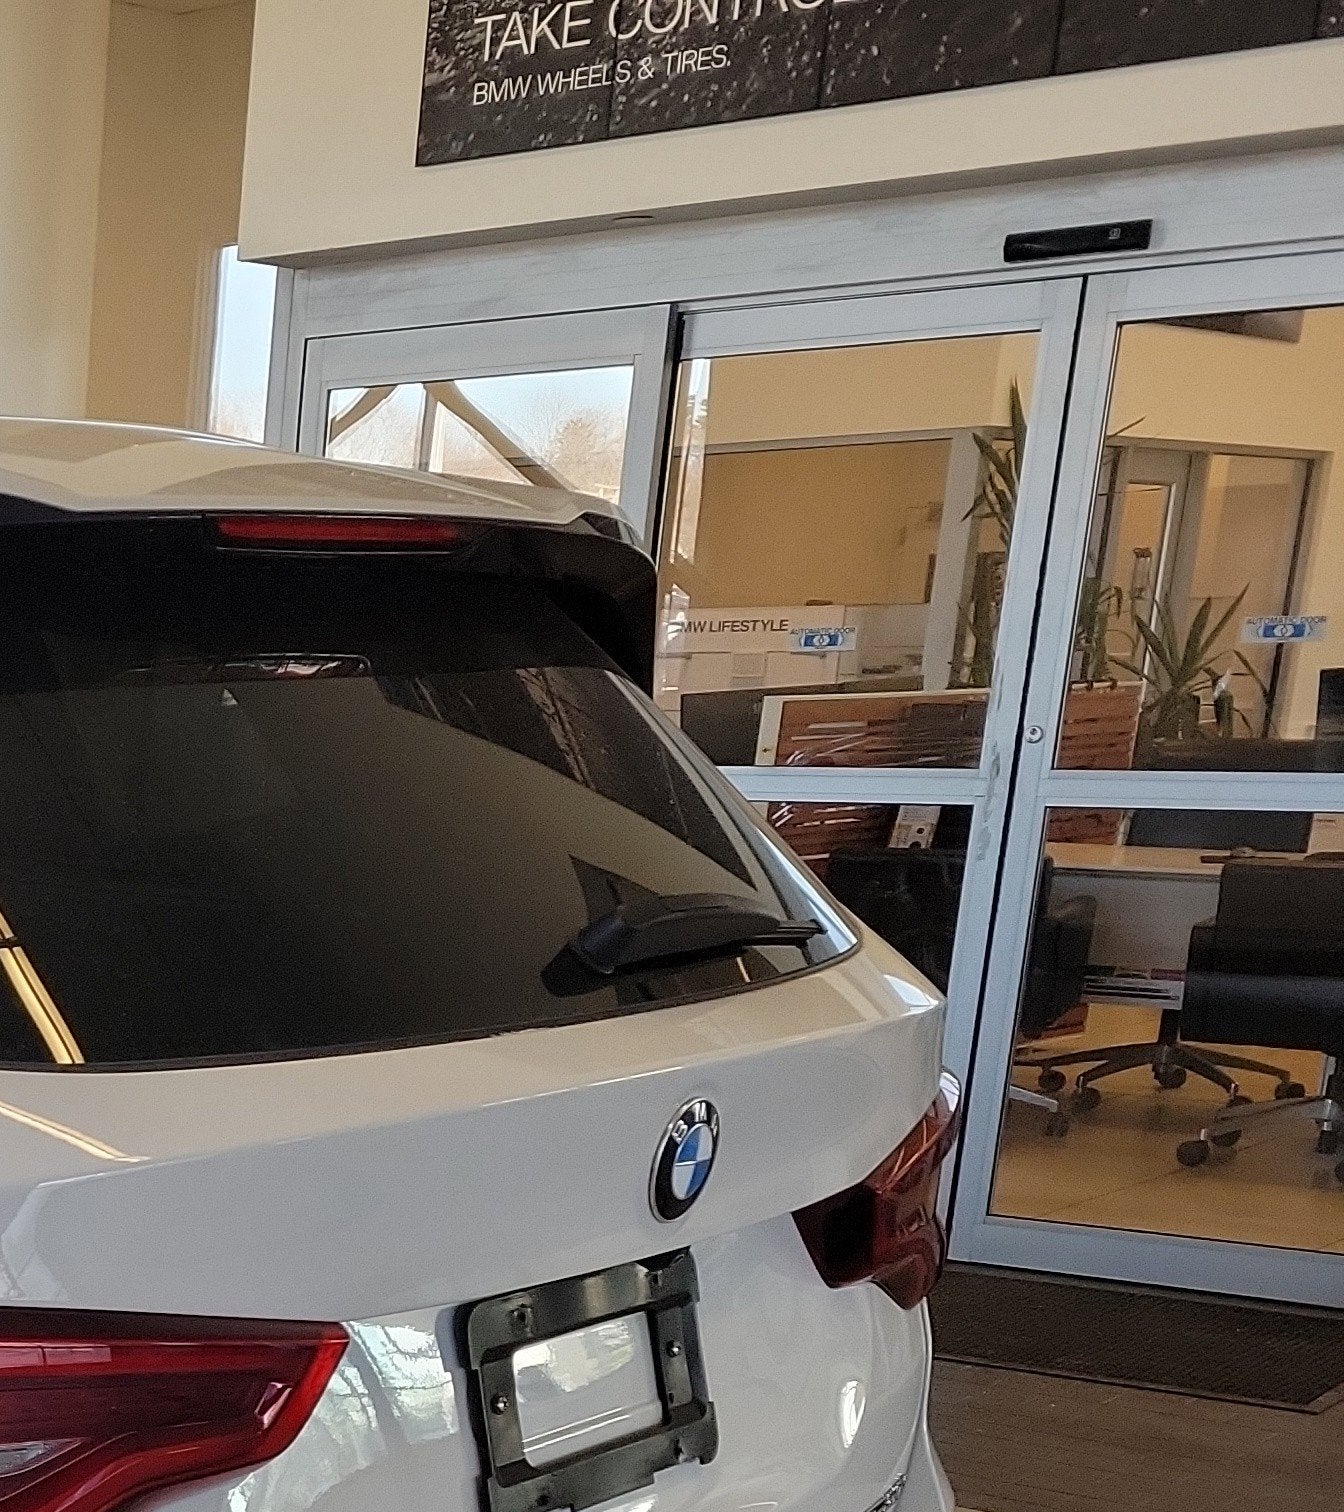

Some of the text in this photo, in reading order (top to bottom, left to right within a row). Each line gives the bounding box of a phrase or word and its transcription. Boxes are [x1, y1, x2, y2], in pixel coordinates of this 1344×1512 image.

[473, 0, 594, 62] TAKE
[472, 44, 732, 106] BMW WHEELS & TIRES.
[670, 619, 789, 633] MW LIFESTYLE
